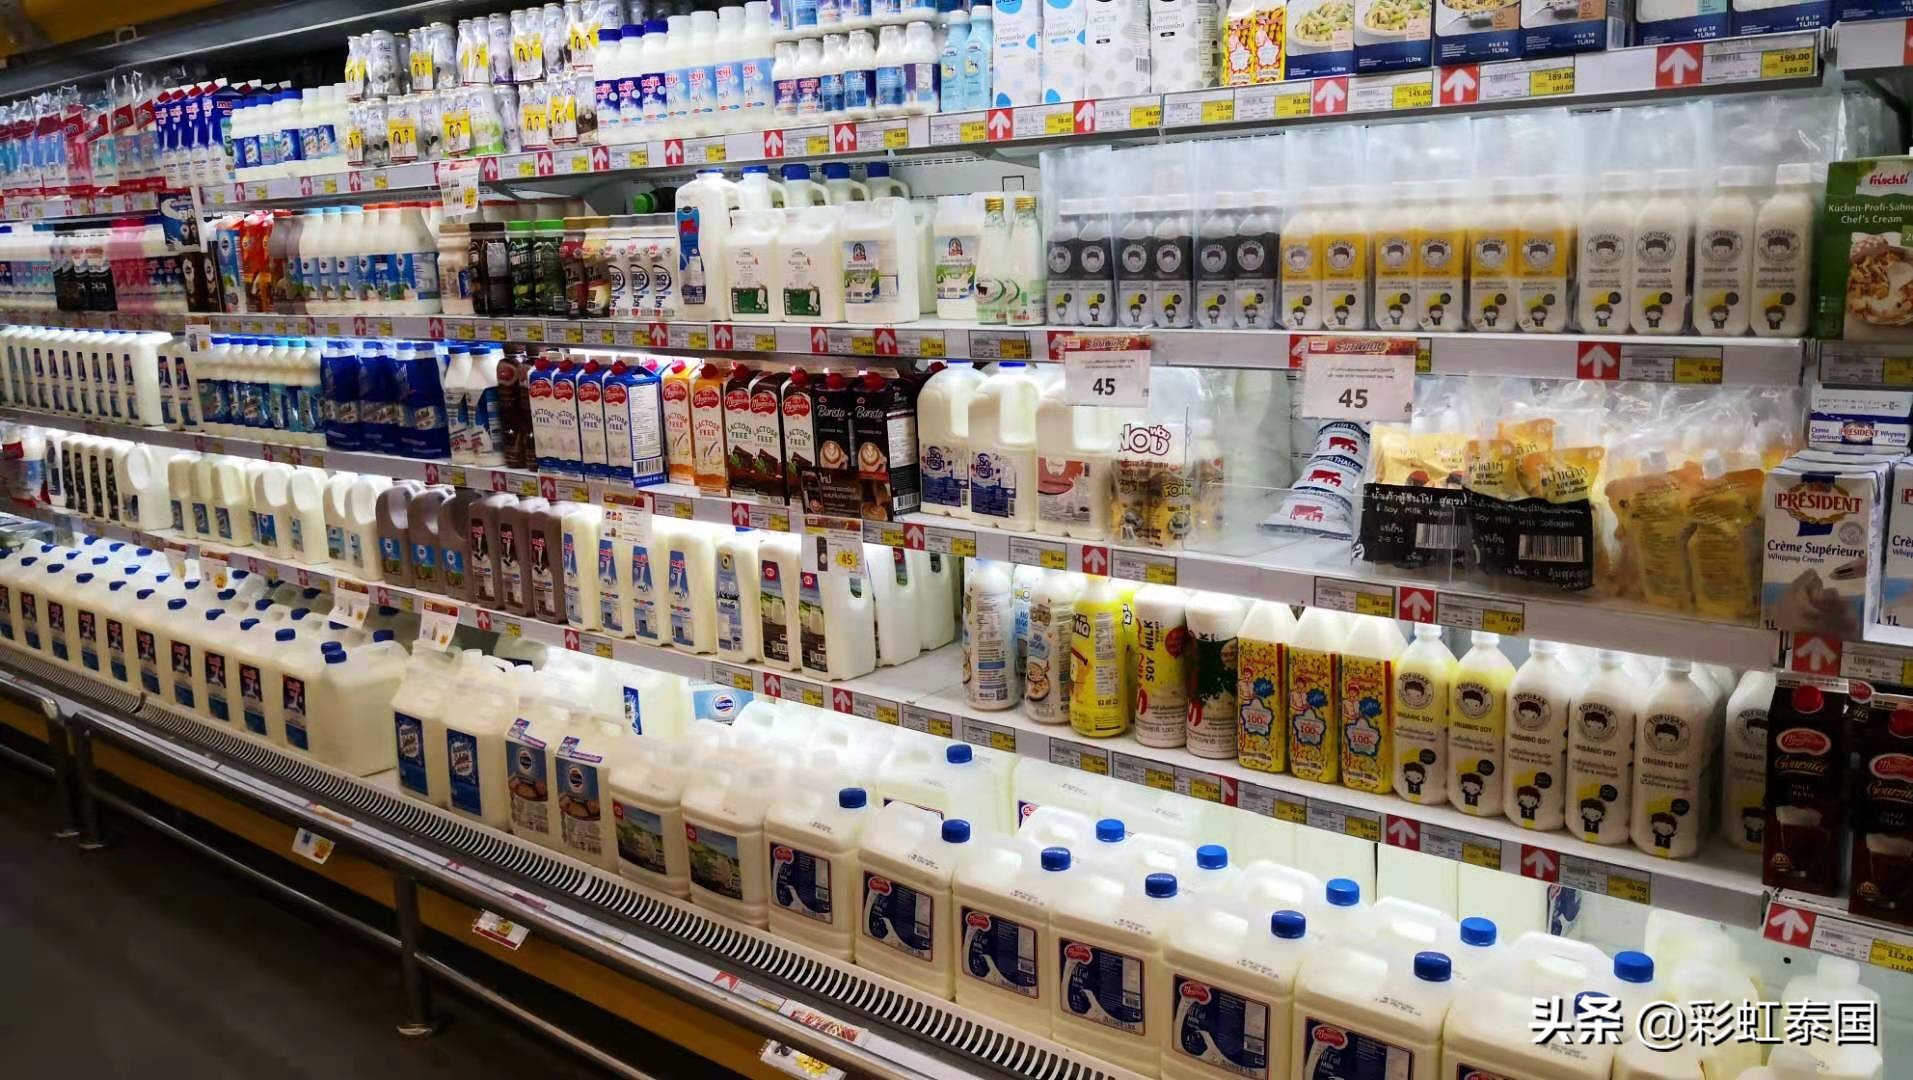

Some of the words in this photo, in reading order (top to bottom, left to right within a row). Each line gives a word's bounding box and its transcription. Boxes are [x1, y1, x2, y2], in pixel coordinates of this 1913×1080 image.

[1780, 53, 1810, 63] 199.00
[1870, 173, 1908, 185] frischli
[1840, 215, 1869, 224] Chef's
[1872, 216, 1902, 224] Cream
[1092, 378, 1116, 395] 45
[1338, 388, 1369, 409] 45
[818, 405, 851, 418] Barista
[857, 405, 889, 418] Barista
[694, 419, 720, 431] LACTOSE
[727, 422, 752, 434] LACTOSE
[753, 425, 779, 438] LACTOSE
[731, 432, 748, 440] FREE
[790, 438, 807, 446] FREE
[1777, 491, 1862, 513] PRÉSIDENT
[1767, 539, 1802, 554] Crème
[1804, 542, 1865, 560] Supérieure
[841, 553, 854, 566] 45
[1768, 553, 1801, 564] Whipping
[1802, 555, 1825, 564] Cream
[1765, 619, 1779, 631] 1L
[1886, 615, 1900, 627] 1L
[1144, 620, 1156, 651] MILK
[1146, 658, 1155, 682] SOY
[1514, 692, 1546, 706] TOFUSAN
[1578, 702, 1614, 716] TOFUSAN
[1648, 712, 1686, 728] TOFUSAN
